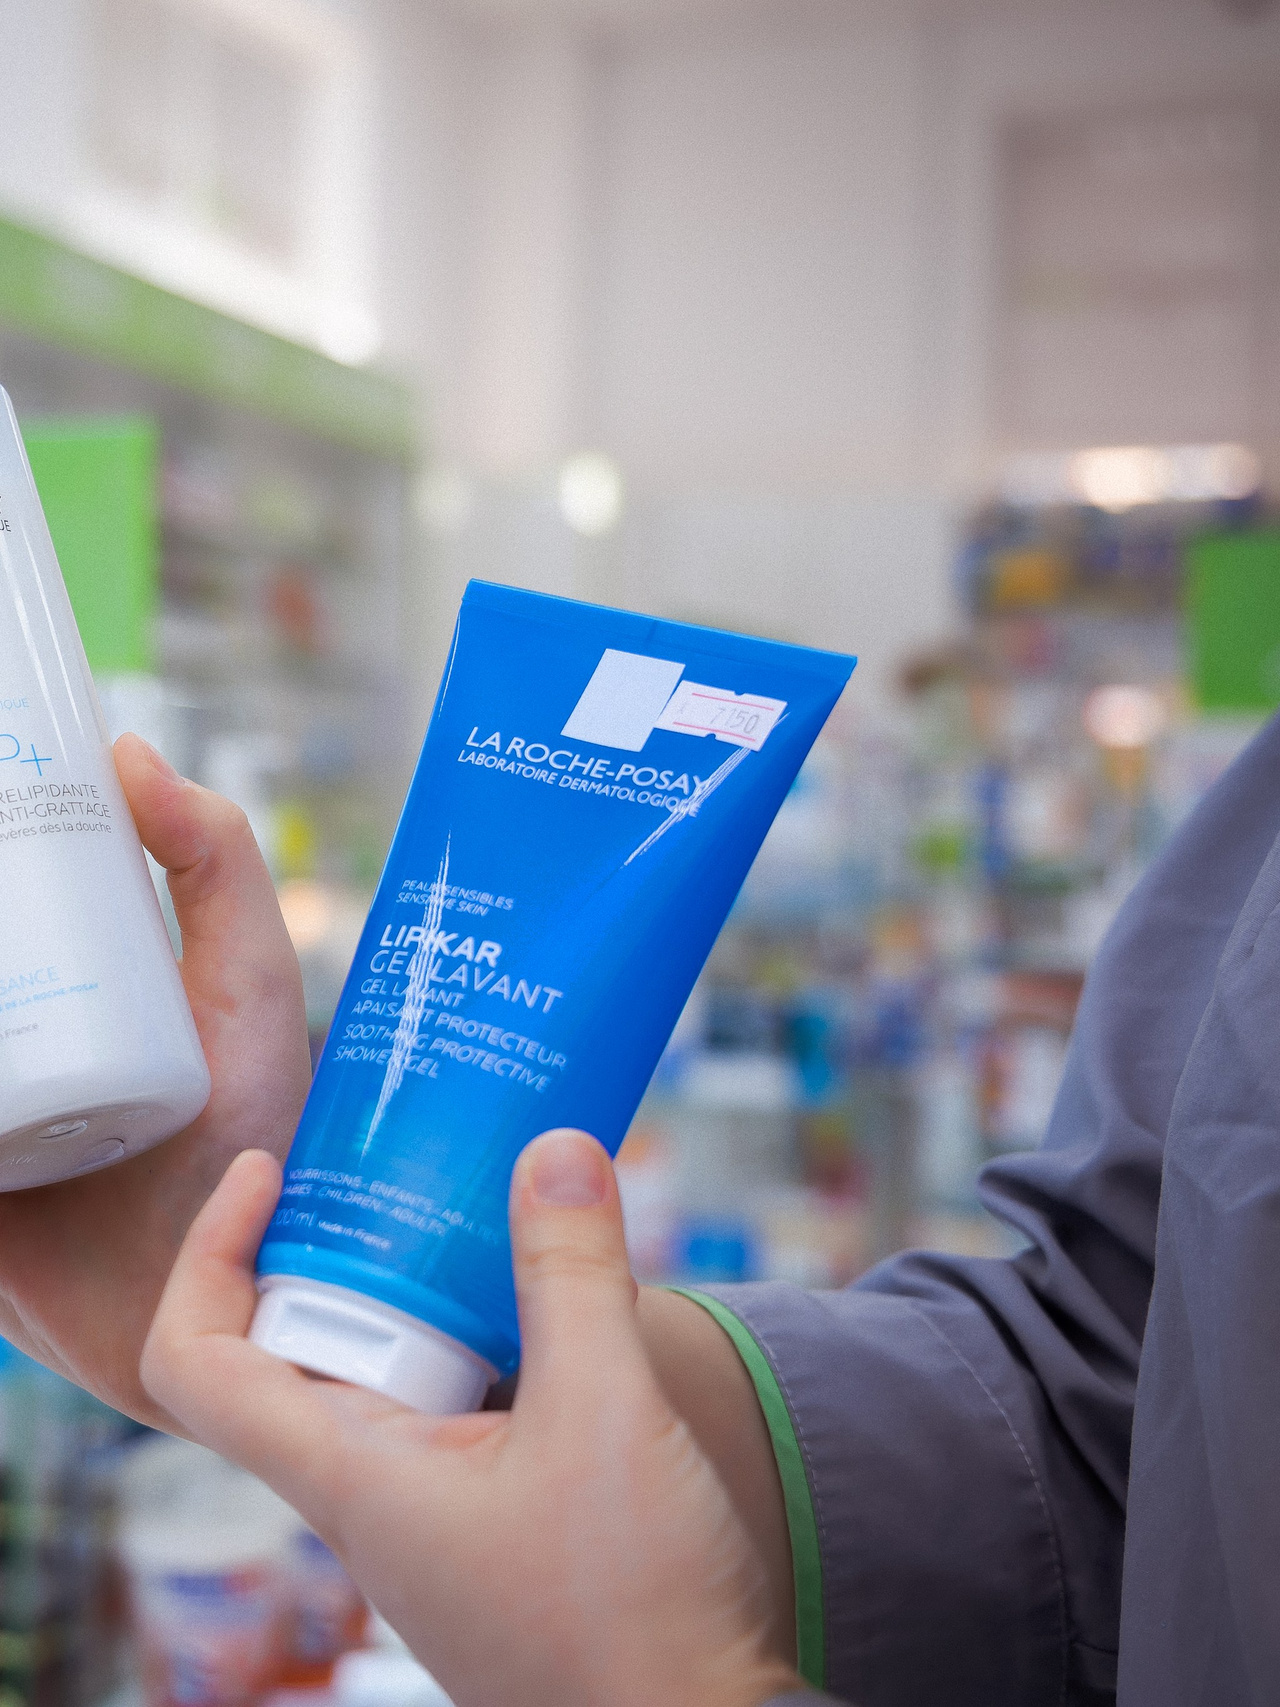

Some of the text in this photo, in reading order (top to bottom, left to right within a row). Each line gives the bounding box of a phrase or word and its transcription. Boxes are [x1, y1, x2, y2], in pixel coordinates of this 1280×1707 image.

[708, 707, 761, 734] 7150
[465, 726, 708, 796] LA ROCHE-POSAY
[458, 750, 701, 817] LABORATOIRE DERMATOLOGIQE
[39, 822, 61, 834] dès
[62, 820, 74, 832] la
[75, 821, 112, 833] douche
[396, 892, 489, 916] SENSIVE SKIN
[443, 883, 515, 910] SENSIBLES
[360, 979, 465, 1008] GEL LAANT
[370, 949, 564, 1014] GEL LAVANT
[4, 1022, 39, 1038] France
[351, 1000, 567, 1071] APAISAT PROTECTEUR
[333, 1045, 439, 1080] SHOWE GEL
[342, 1023, 552, 1093] SOOTHG PROTECTIVE
[318, 1185, 380, 1212] CHILDREN
[389, 1206, 447, 1237] ADULTS
[369, 1180, 433, 1213] ENFANTS
[296, 1210, 317, 1228] ml
[354, 1228, 392, 1251] France
